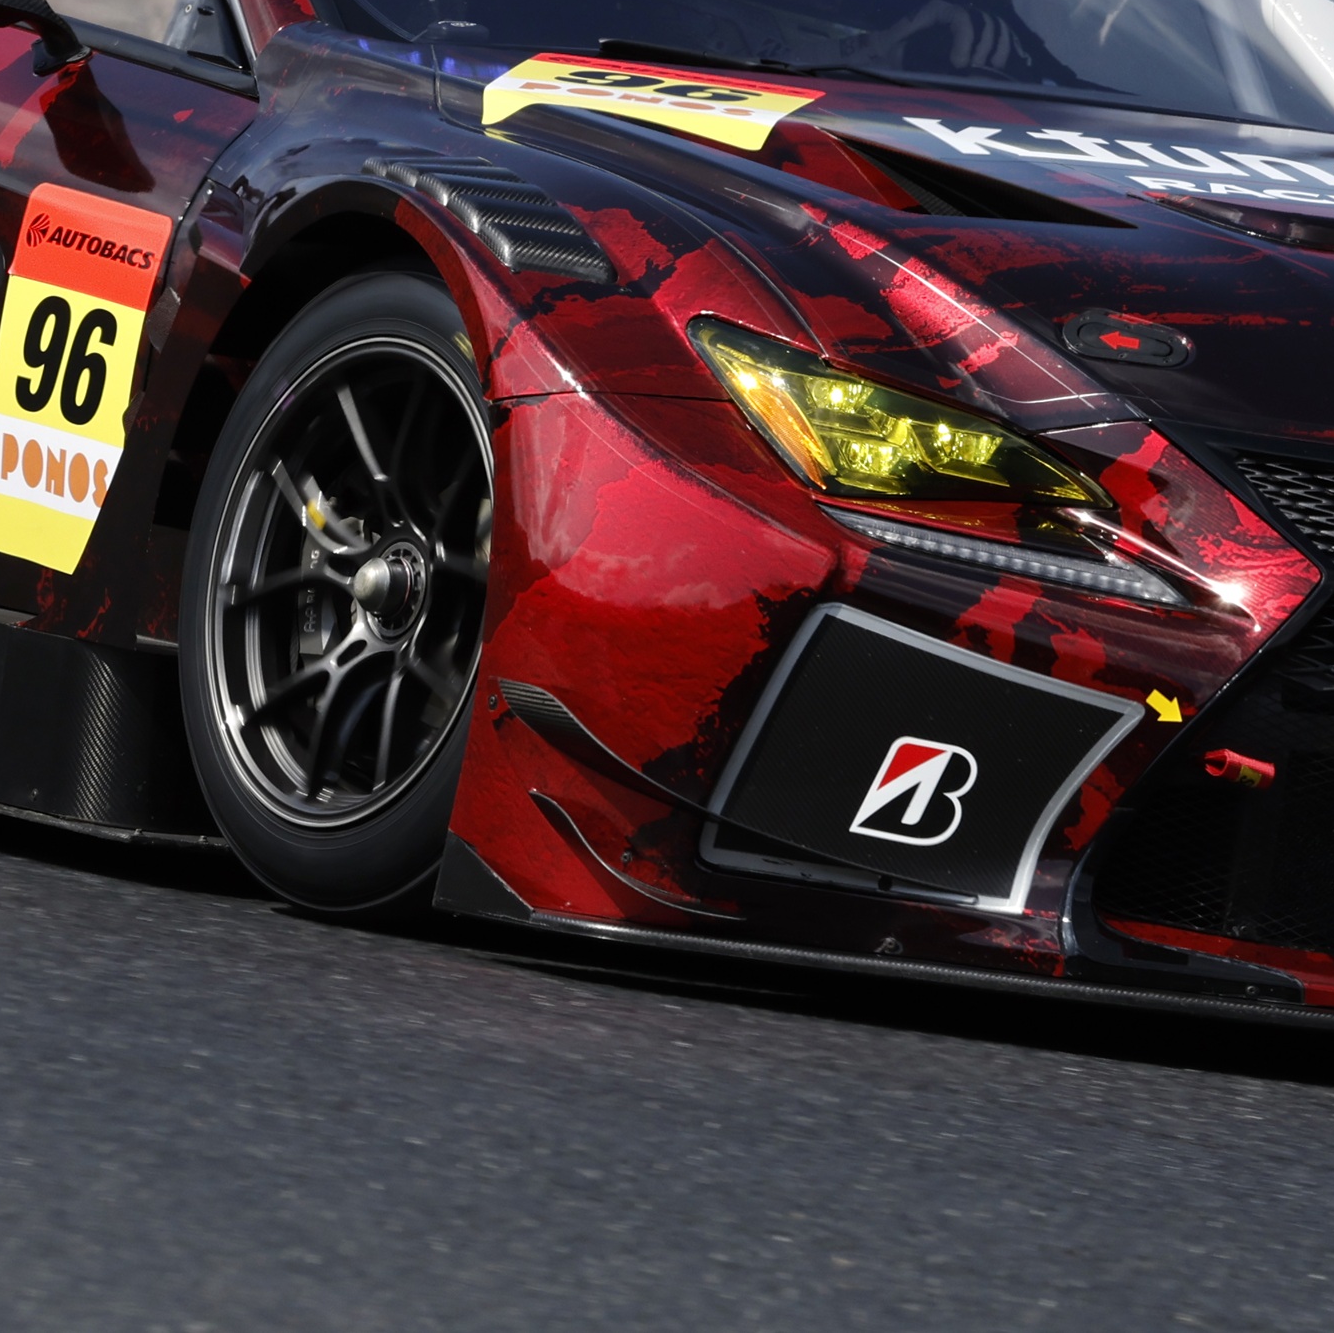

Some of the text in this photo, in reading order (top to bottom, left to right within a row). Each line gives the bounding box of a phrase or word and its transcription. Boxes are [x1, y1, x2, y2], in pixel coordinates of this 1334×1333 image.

[518, 81, 754, 116] PONOS
[554, 70, 762, 101] 96
[46, 225, 155, 270] AUTOBACS
[15, 295, 117, 425] 96
[0, 433, 108, 508] PONOS
